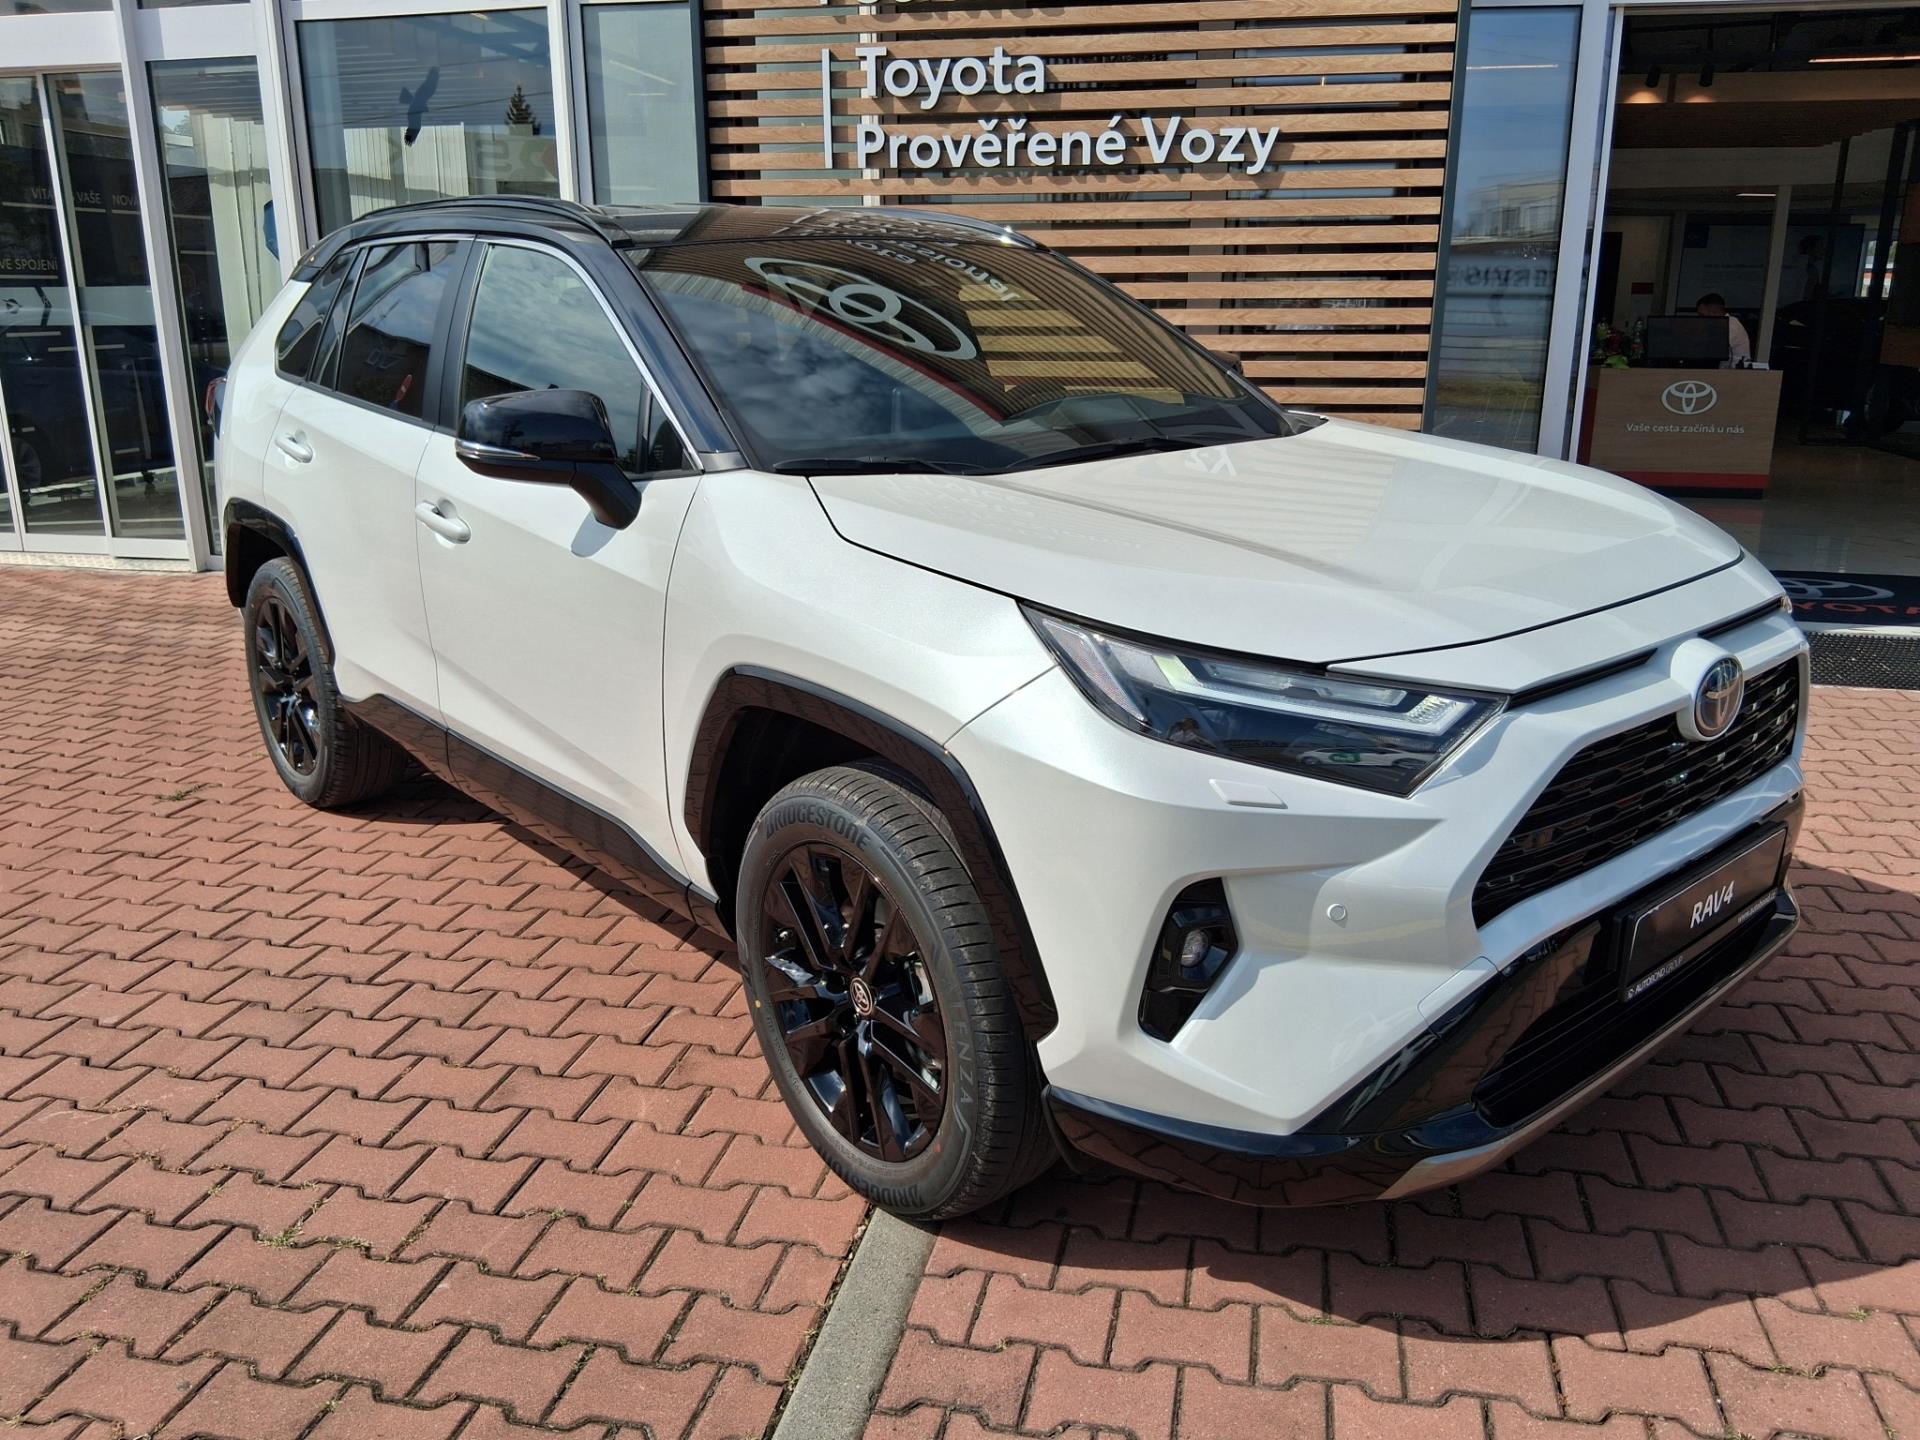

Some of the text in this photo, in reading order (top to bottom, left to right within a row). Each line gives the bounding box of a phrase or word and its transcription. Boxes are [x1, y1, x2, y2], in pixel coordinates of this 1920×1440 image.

[855, 46, 1046, 110] Toyota
[856, 116, 1280, 175] Prověřené Vozy
[1625, 422, 1745, 434] Vaše cesta začíná u nás
[765, 803, 871, 852] BRIDGESTONE
[1689, 880, 1735, 929] RAV4
